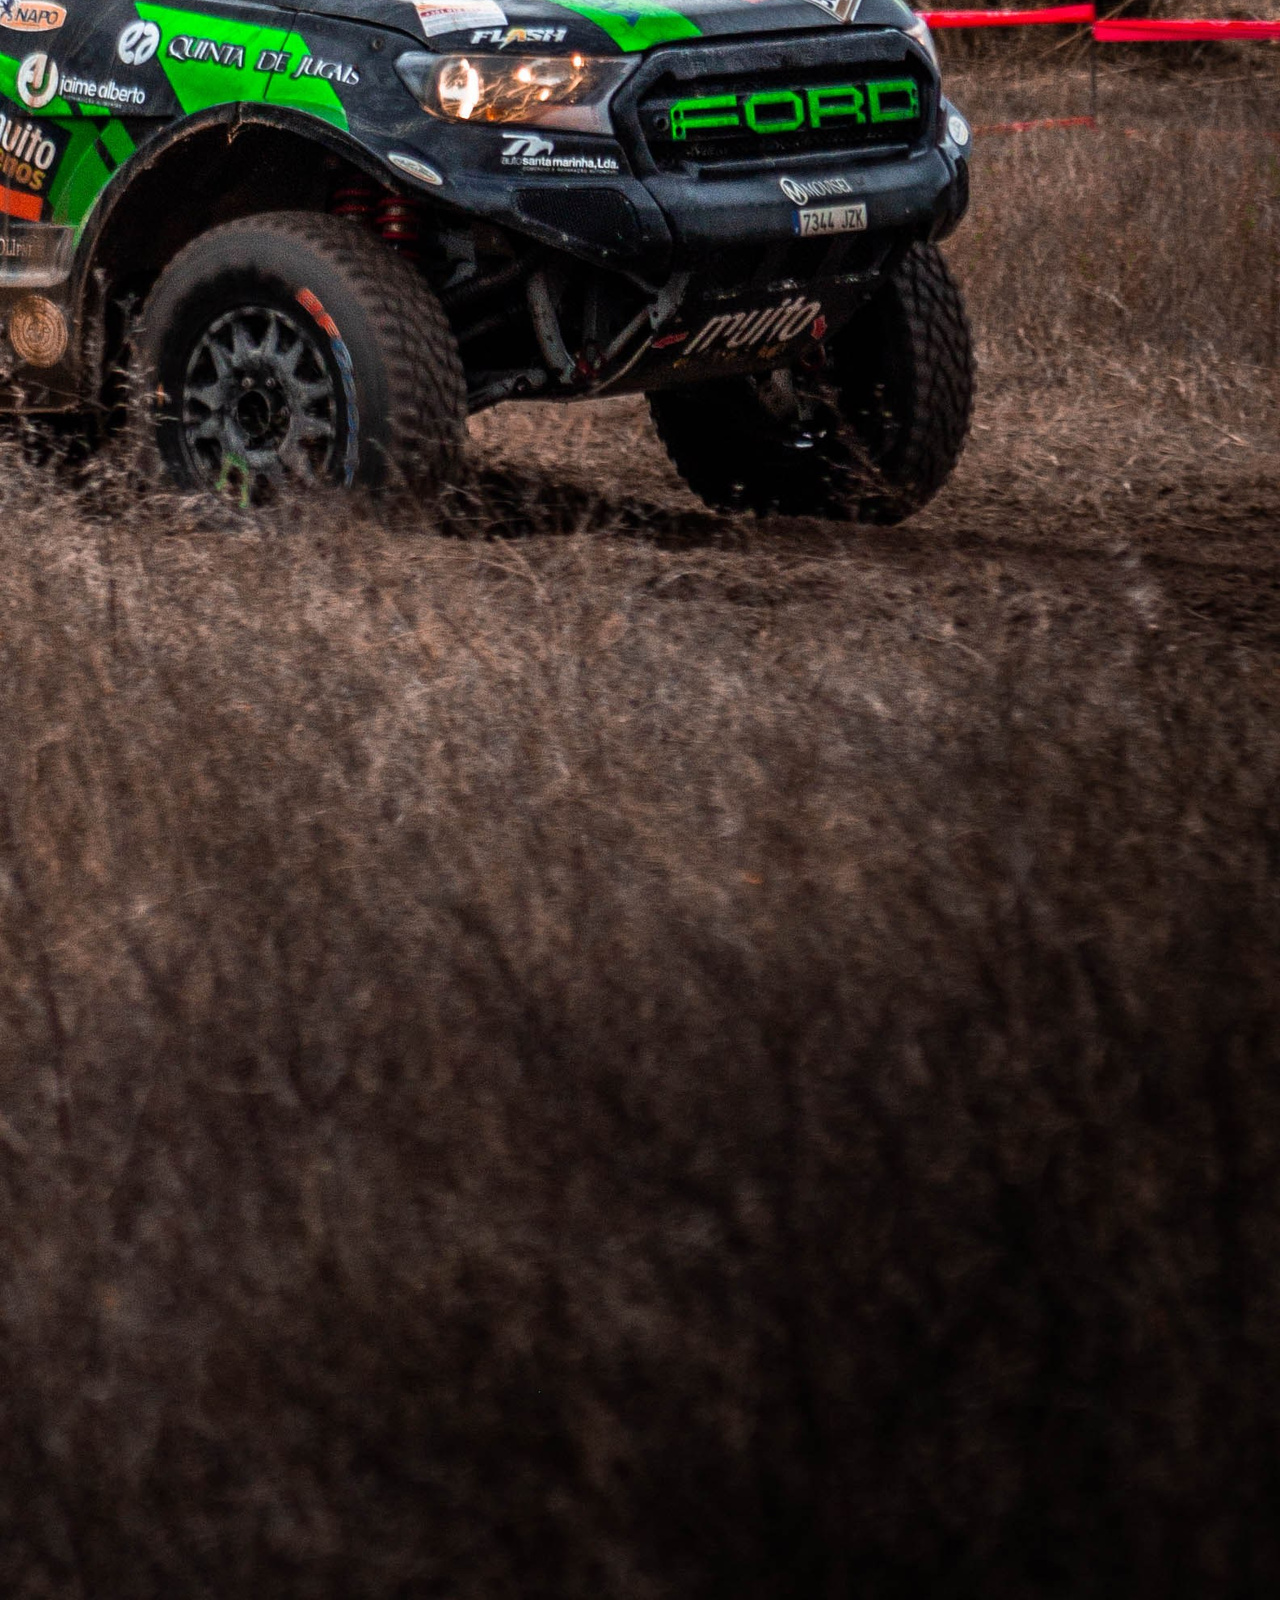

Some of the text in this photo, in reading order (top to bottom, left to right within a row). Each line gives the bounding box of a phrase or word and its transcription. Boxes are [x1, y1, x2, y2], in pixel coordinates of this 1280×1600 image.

[14, 7, 58, 25] NAPO
[470, 28, 567, 50] FLASH
[169, 36, 360, 85] QUINTA DE JUGAIS
[59, 74, 97, 96] jaime
[98, 79, 146, 104] alberto
[670, 78, 919, 140] FORD
[803, 209, 863, 235] 7344 JZK
